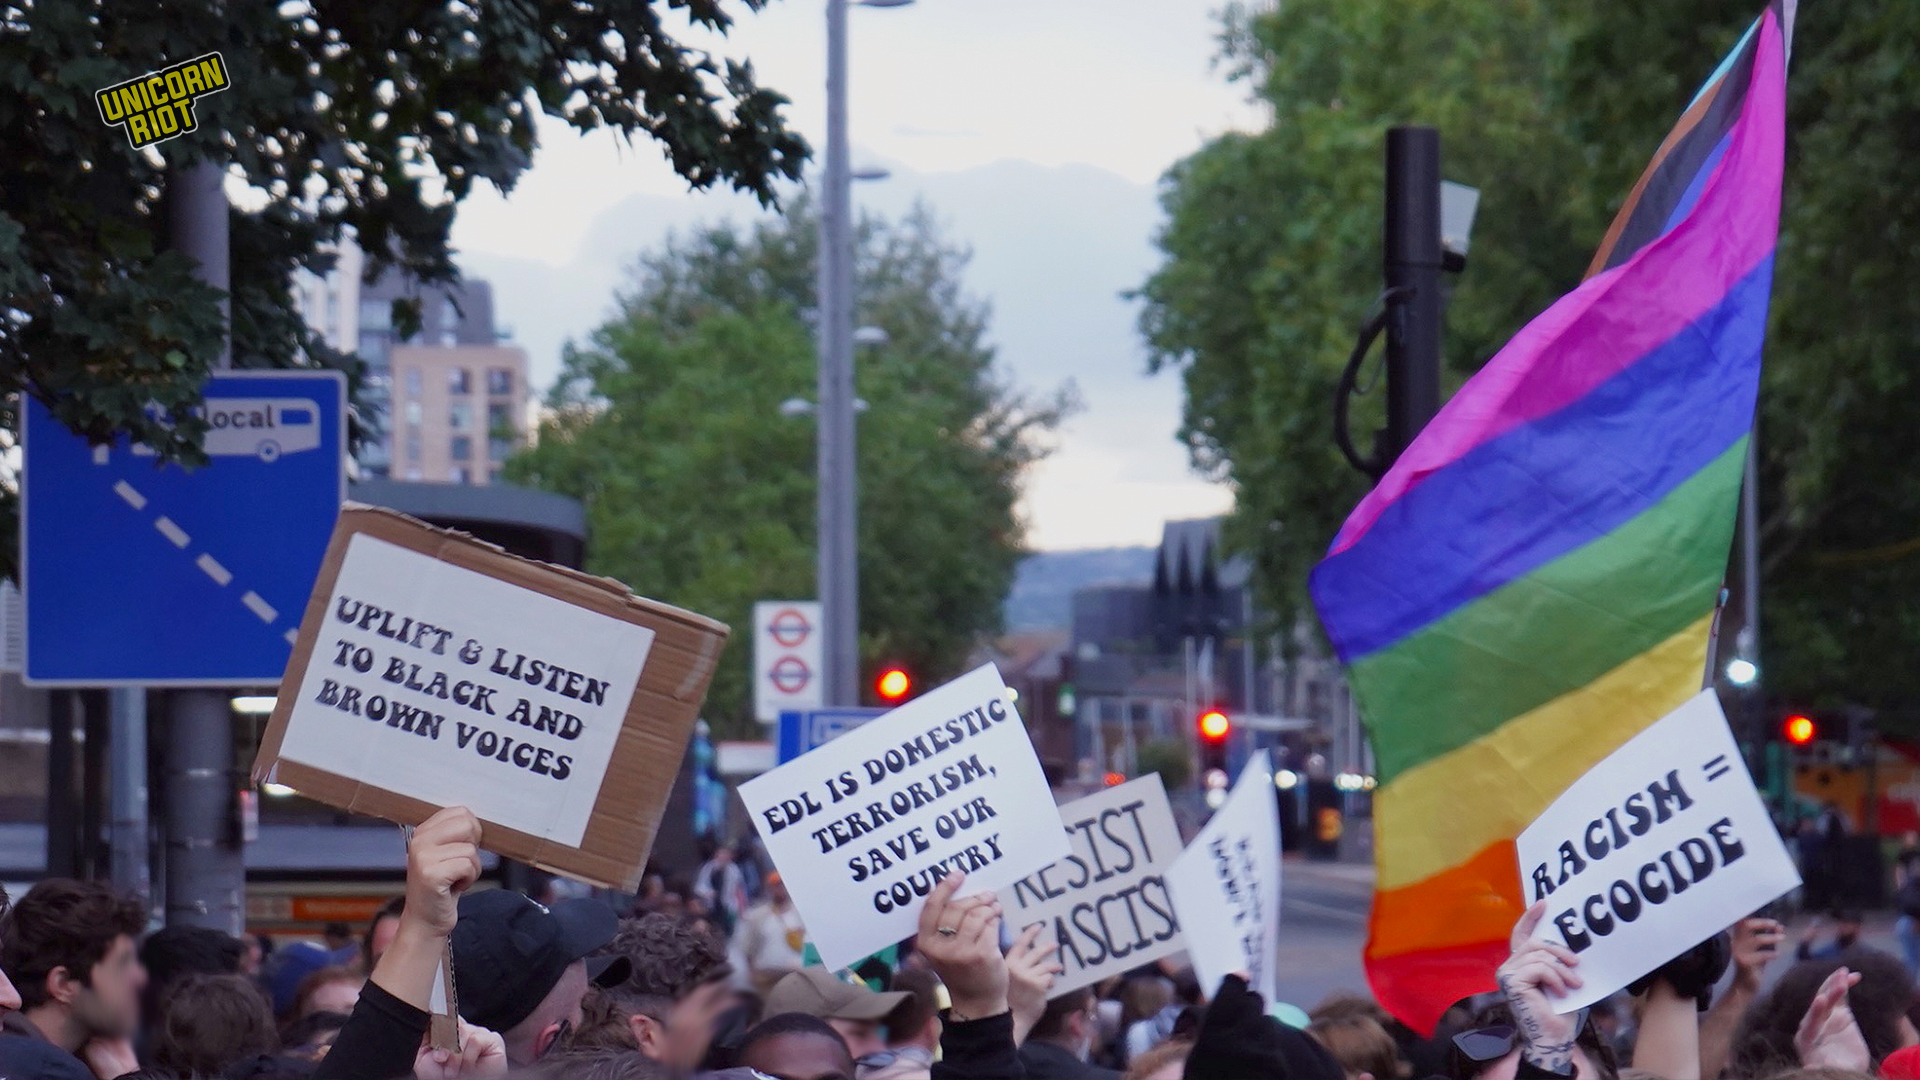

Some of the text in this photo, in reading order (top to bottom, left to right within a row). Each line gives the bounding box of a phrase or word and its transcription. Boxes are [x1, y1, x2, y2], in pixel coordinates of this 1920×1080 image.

[333, 639, 586, 740] TO BLACK AND
[336, 595, 611, 706] UPLIFT & LISTEN
[315, 678, 573, 780] BROWN VOICES
[763, 698, 1007, 834] EDL IS DOMESTIC
[812, 754, 997, 854] TERRORISM,
[849, 797, 997, 882] SAVE OUR
[1532, 754, 1731, 901] RACISM =
[874, 833, 1003, 914] COUNTRY
[1554, 817, 1745, 954] ECOCIDE
[1021, 875, 1181, 976] ASCIS
